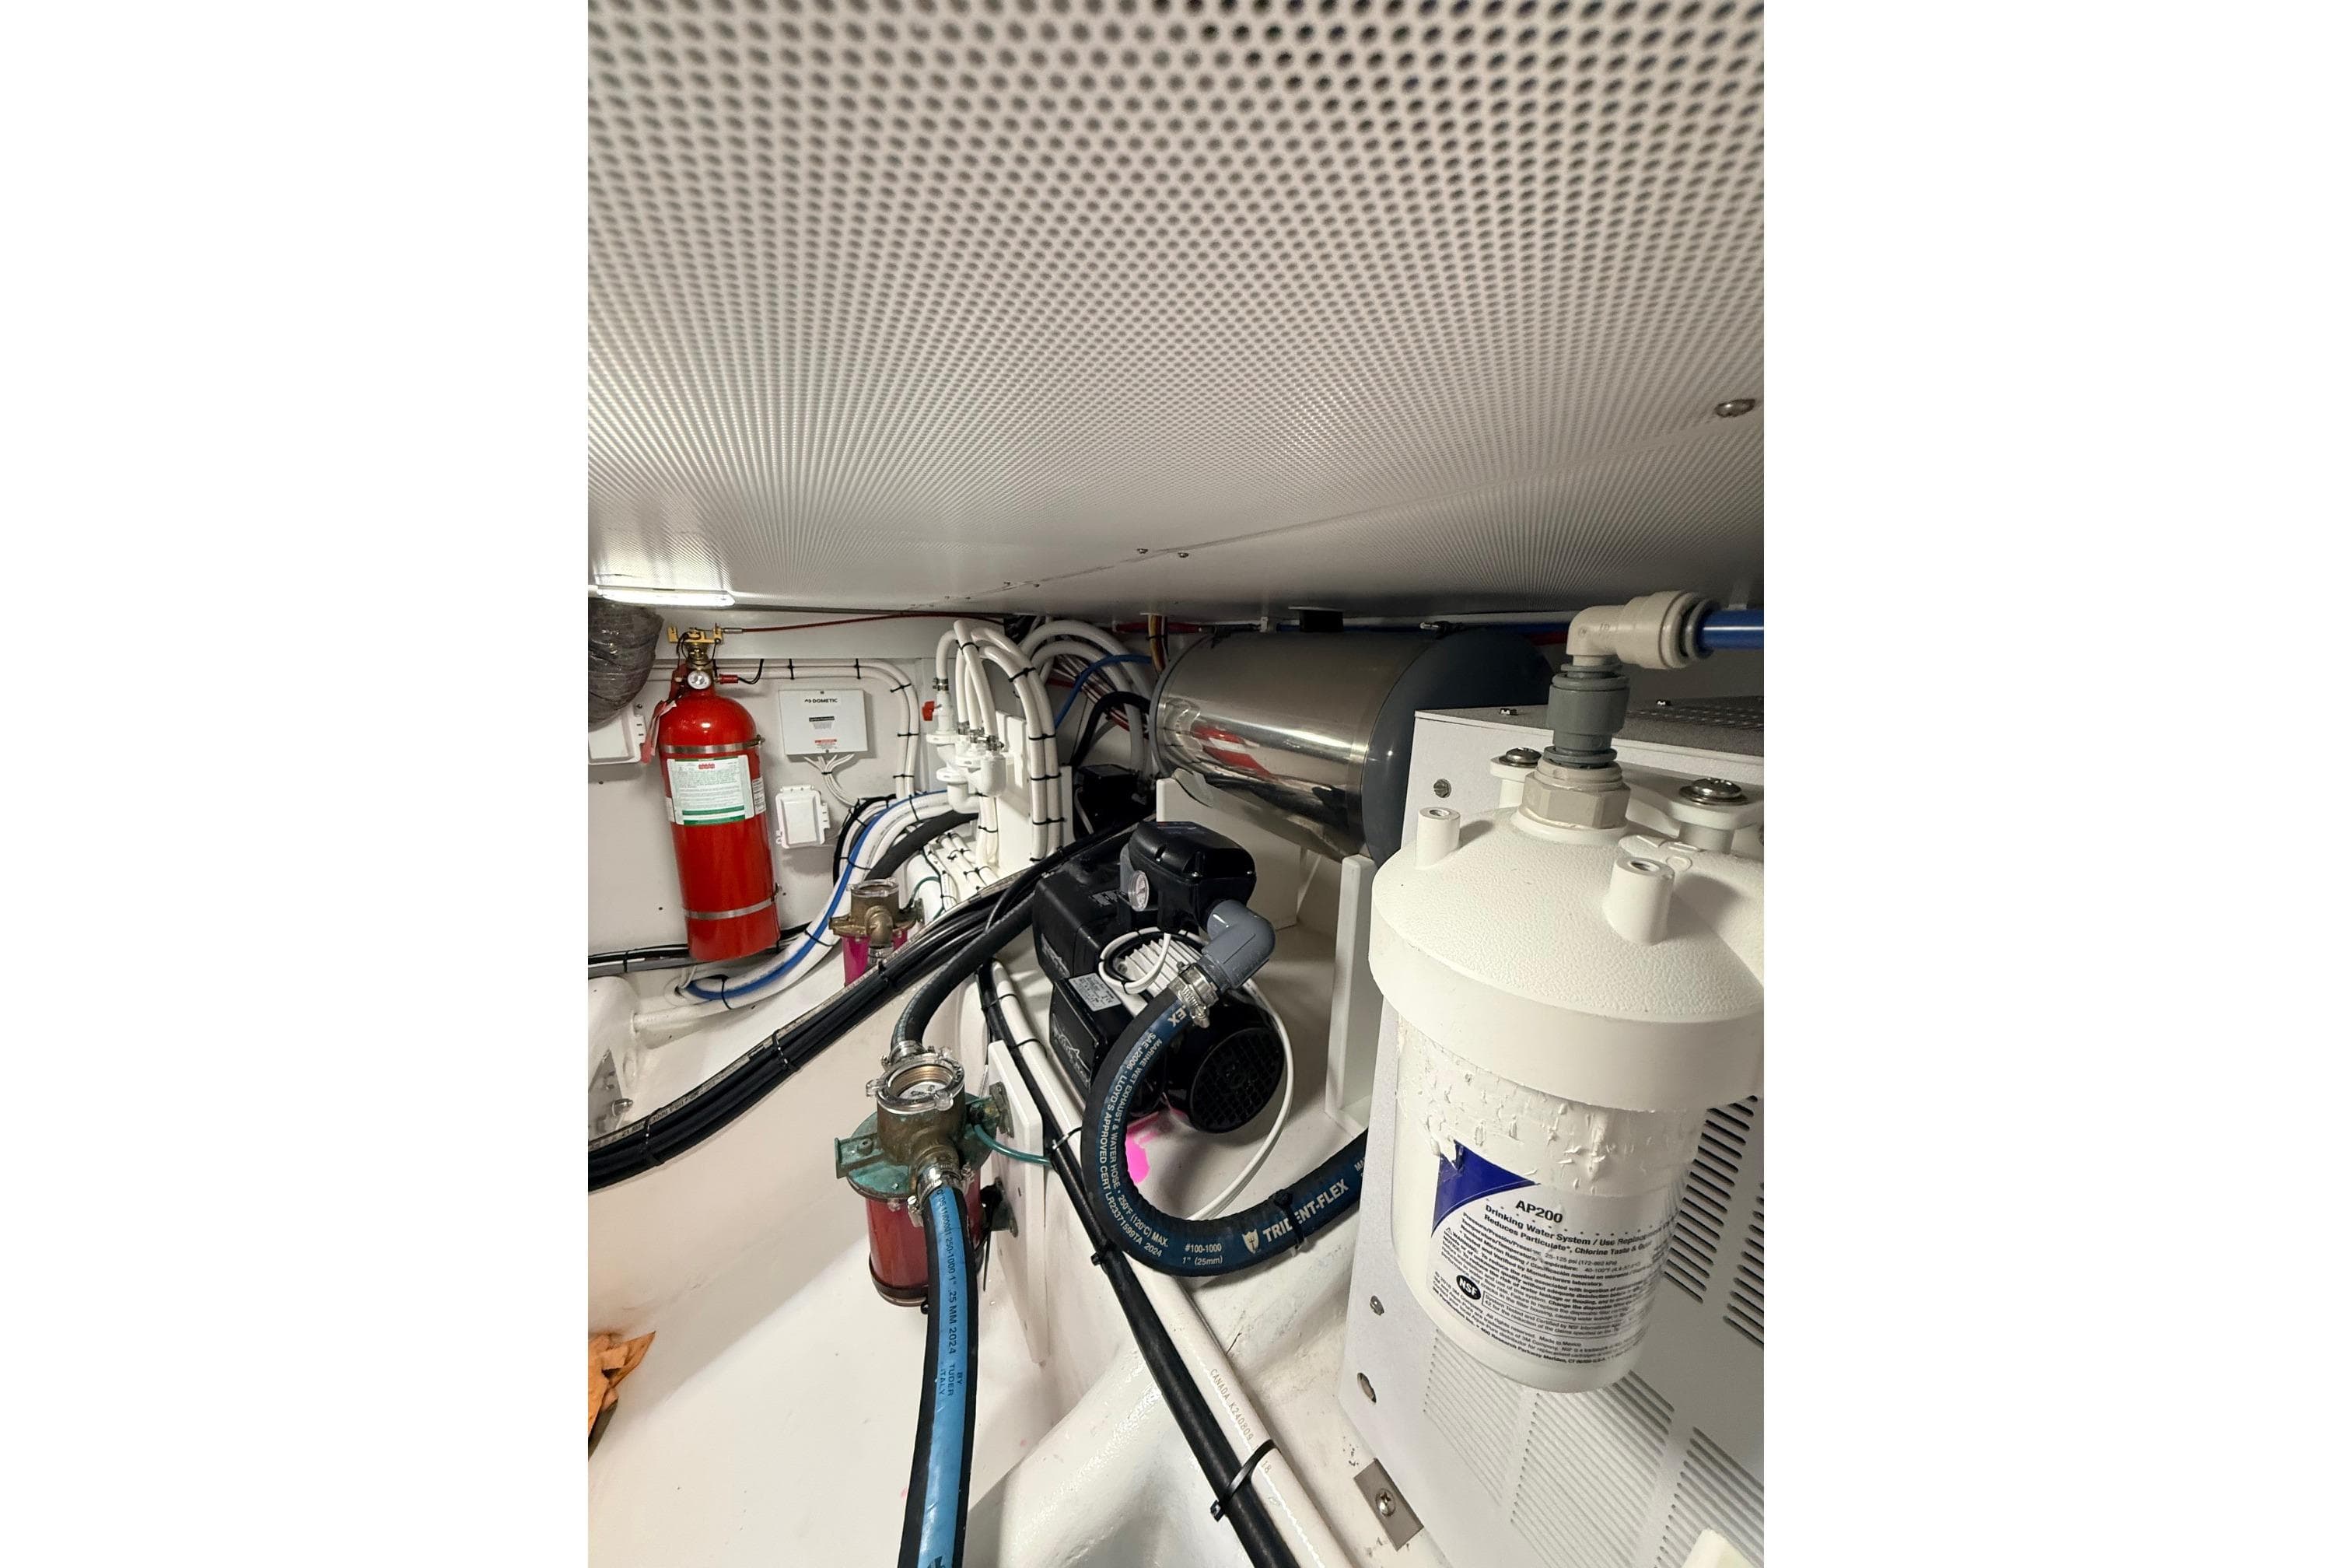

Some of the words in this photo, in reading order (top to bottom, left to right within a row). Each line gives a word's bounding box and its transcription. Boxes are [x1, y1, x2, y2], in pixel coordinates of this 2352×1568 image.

[1139, 1038, 1162, 1067] MARINE
[1141, 1033, 1156, 1048] SAE
[1126, 1047, 1143, 1070] J2006
[1129, 1067, 1143, 1084] WET
[1108, 1075, 1128, 1111] LLOYD'S
[1115, 1084, 1132, 1123] EXHAUST
[1100, 1112, 1112, 1164] APPROVED
[1109, 1132, 1118, 1163] WATER
[1100, 1166, 1111, 1190] CERT
[1111, 1164, 1120, 1188] HOSE
[1516, 1200, 1562, 1223] AP200
[1483, 1213, 1517, 1236] Reduces
[1574, 1247, 1608, 1256] Chlorine
[1485, 1204, 1523, 1229] Drinking
[1525, 1223, 1554, 1239] Water
[1556, 1233, 1590, 1245] System
[946, 1237, 955, 1274] 250-1000
[1144, 1243, 1162, 1257] 2024
[1185, 1244, 1221, 1254] #100-1000
[1195, 1257, 1223, 1265] (25mm)
[1459, 1277, 1478, 1296] NSF
[949, 1305, 957, 1324] MM
[1210, 1369, 1230, 1400] CANADA
